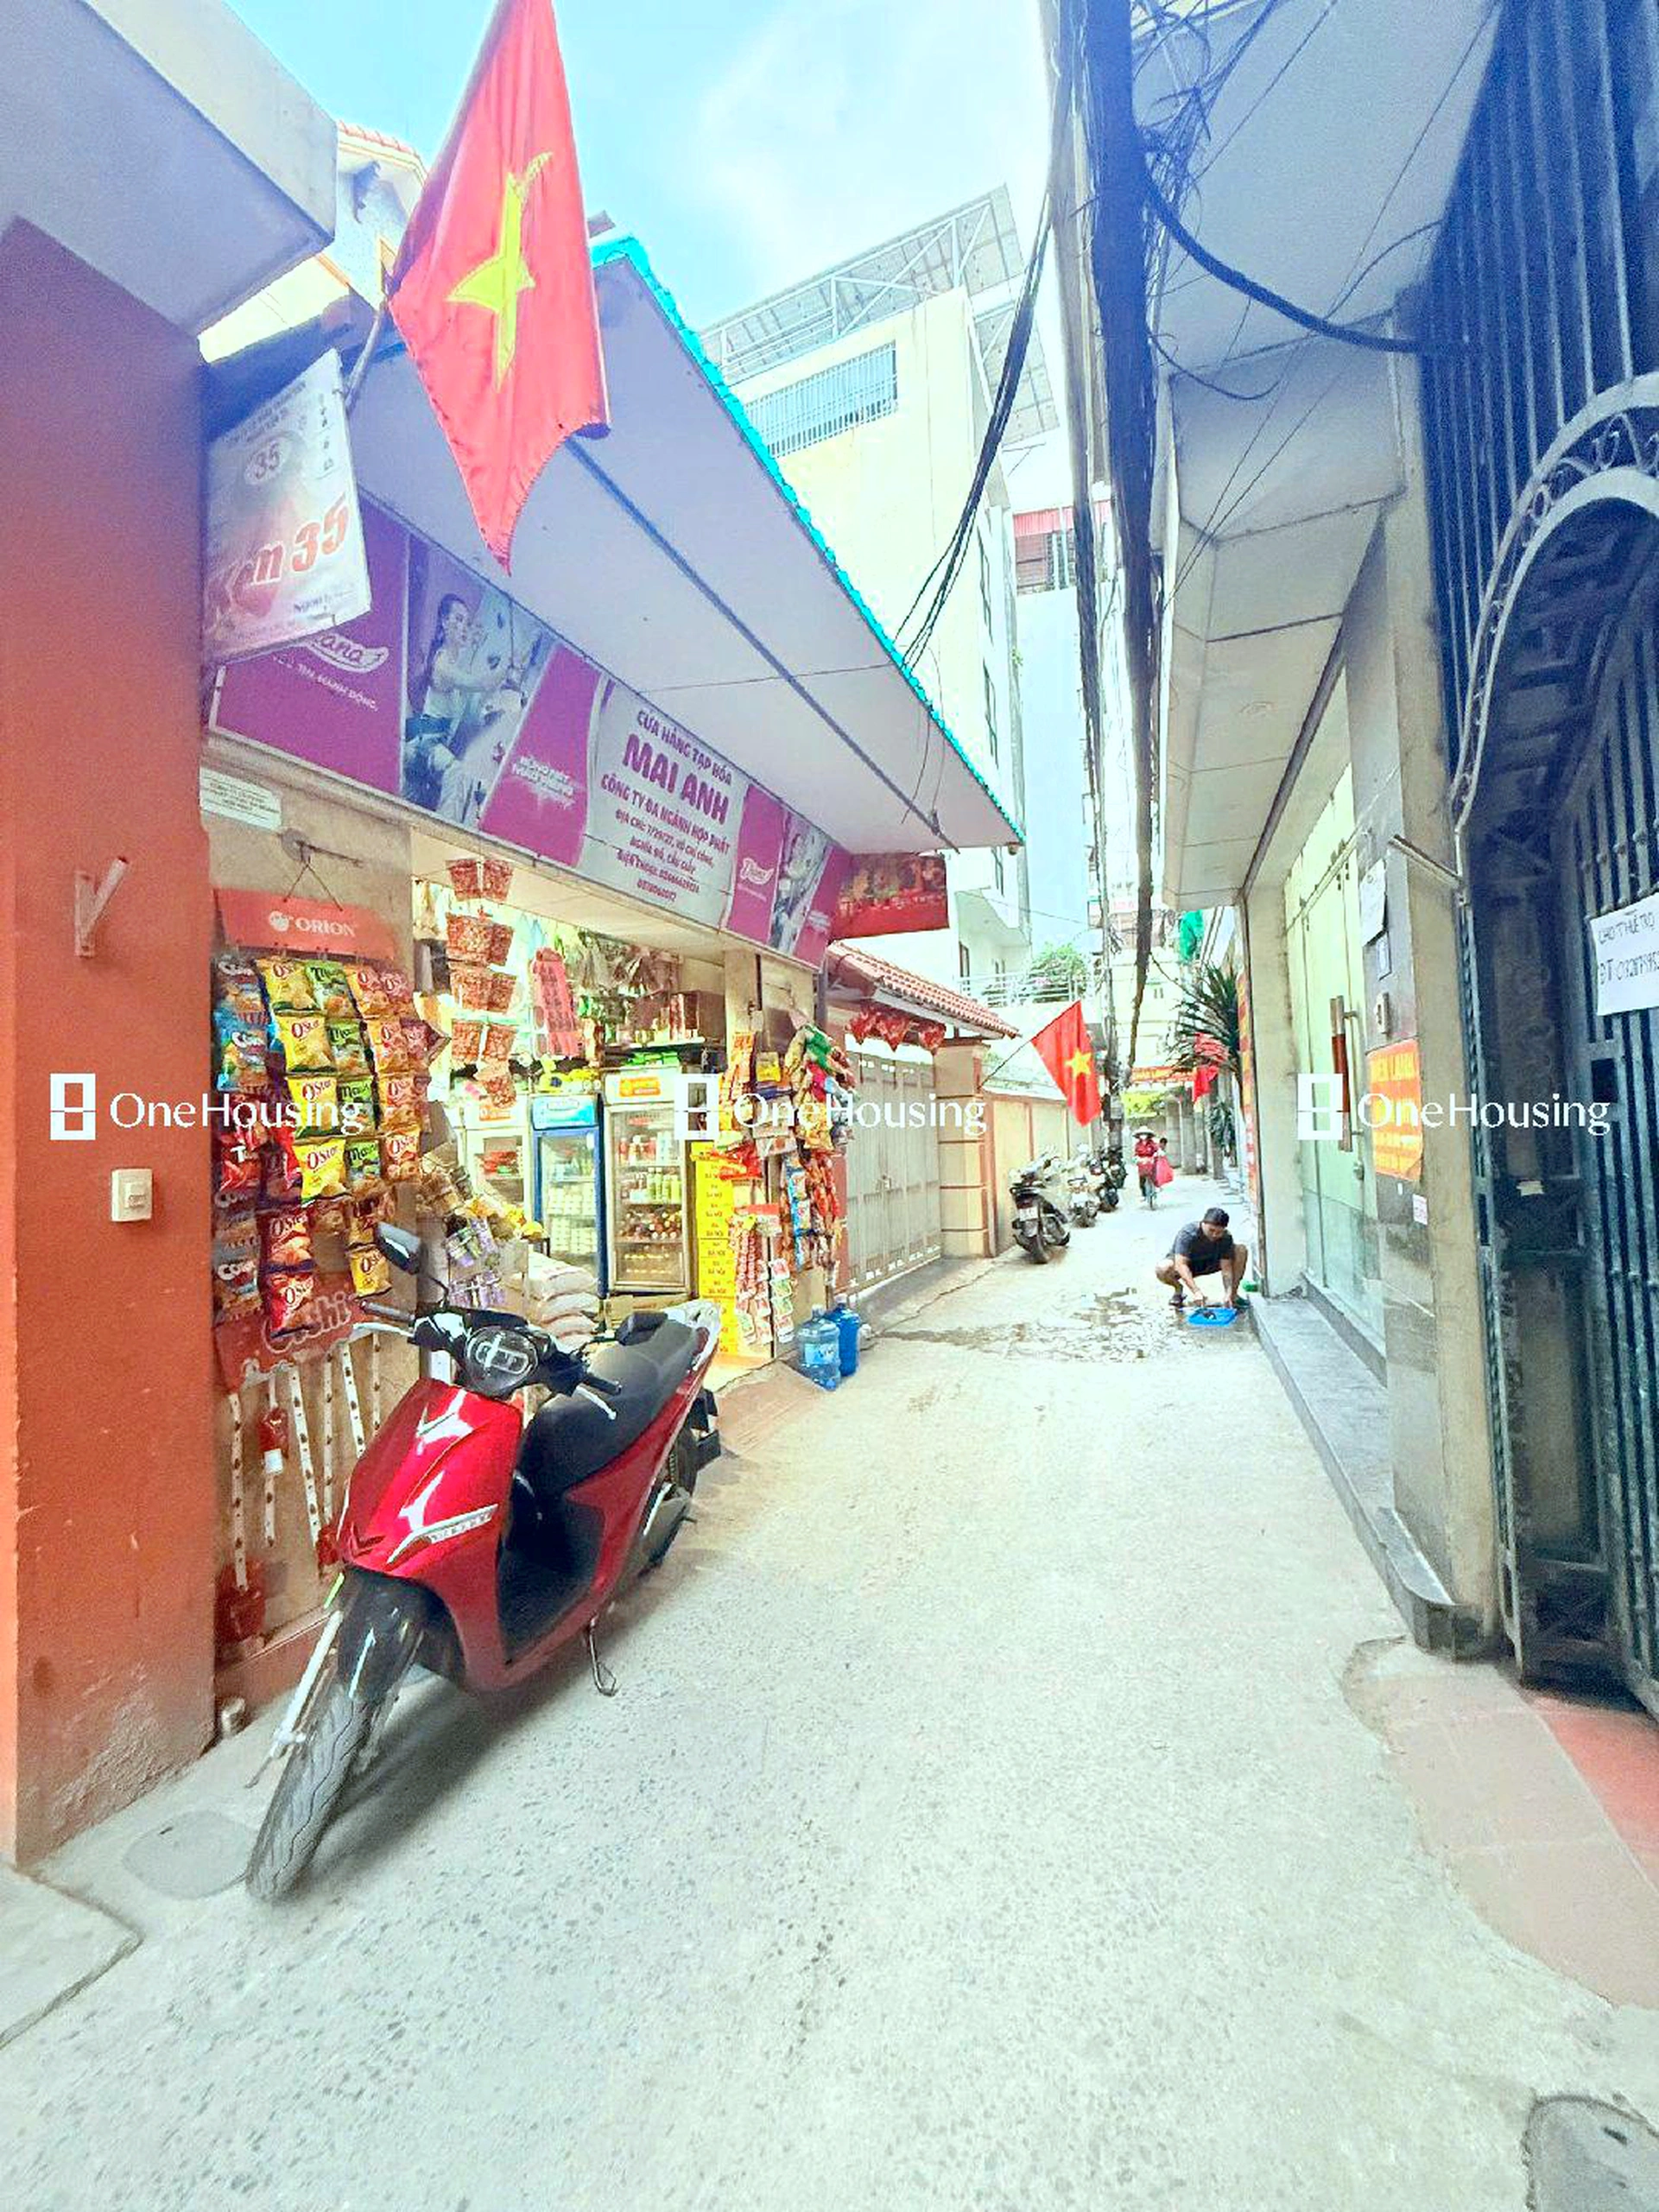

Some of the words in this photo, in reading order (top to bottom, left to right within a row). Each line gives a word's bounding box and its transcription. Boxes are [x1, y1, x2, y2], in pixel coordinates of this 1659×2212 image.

[292, 493, 350, 573] 35
[622, 733, 679, 794] MAI
[680, 772, 729, 825] ANH
[294, 917, 356, 938] ORION
